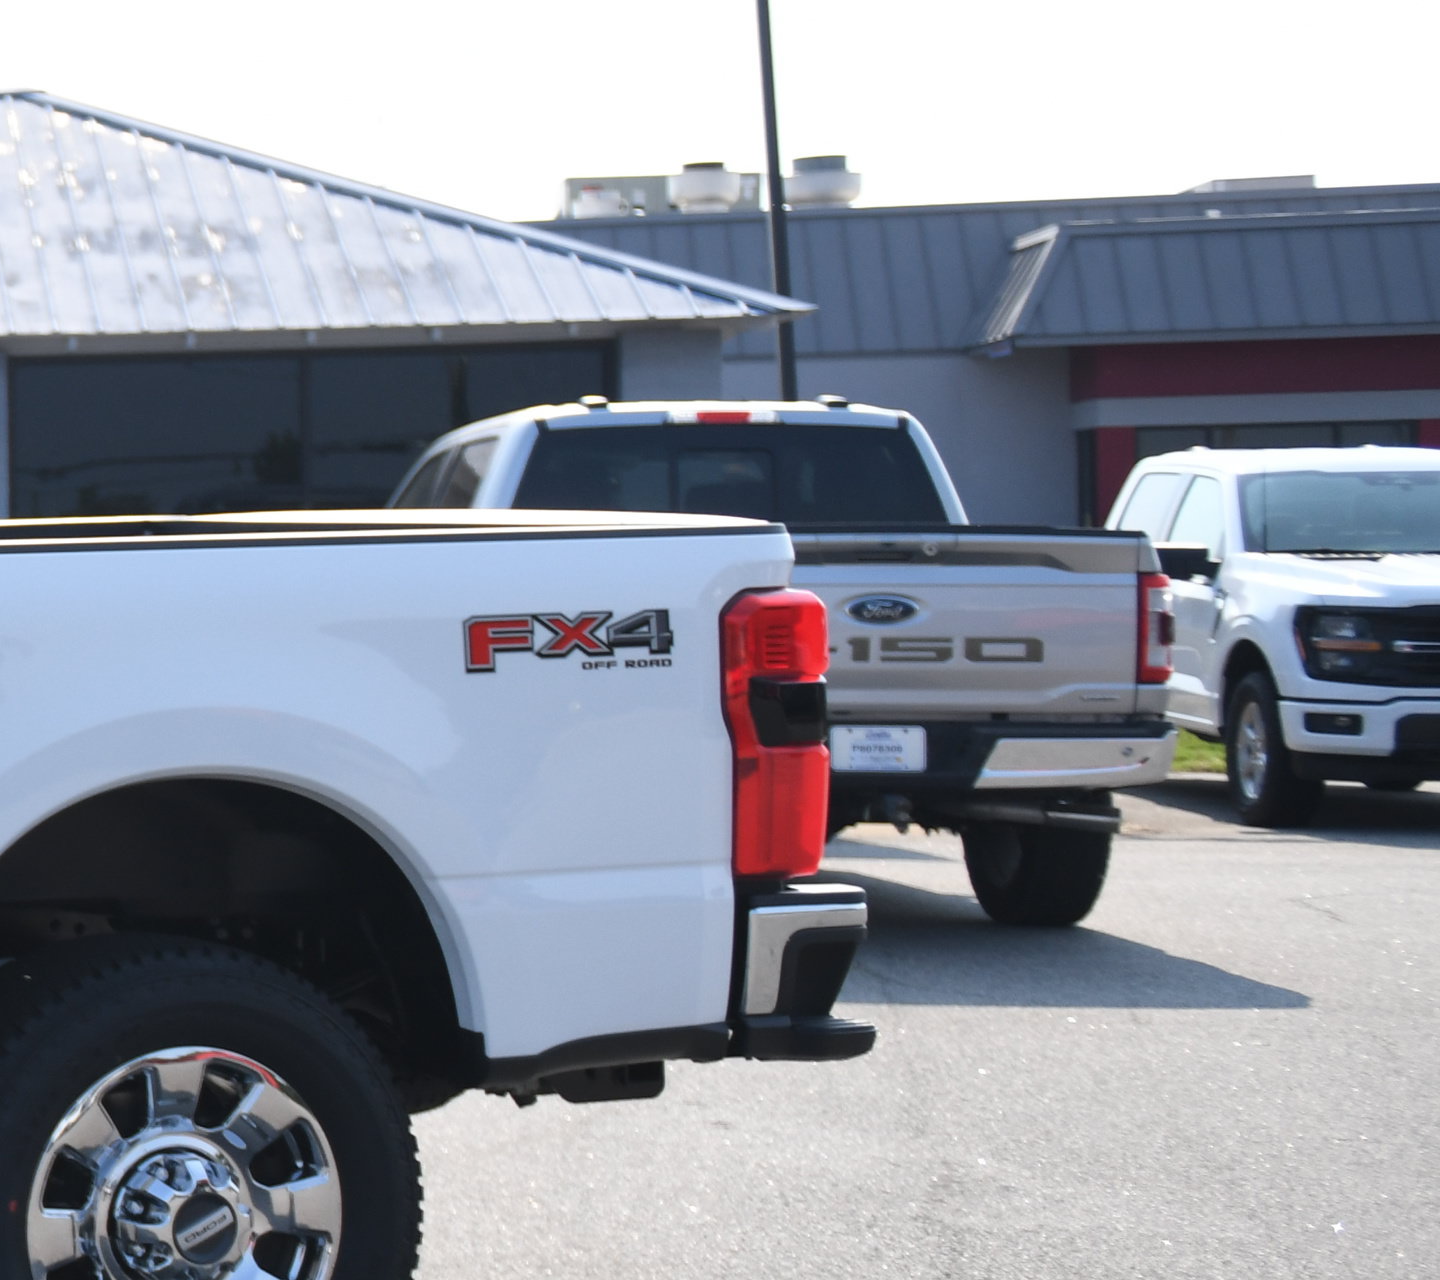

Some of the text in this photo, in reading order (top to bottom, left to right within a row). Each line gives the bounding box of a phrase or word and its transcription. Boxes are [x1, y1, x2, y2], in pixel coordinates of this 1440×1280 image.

[863, 600, 903, 619] Ford
[462, 609, 674, 673] FX4
[829, 637, 1044, 662] -150
[581, 658, 673, 670] OFF ROAD
[184, 1214, 227, 1244] FORD
